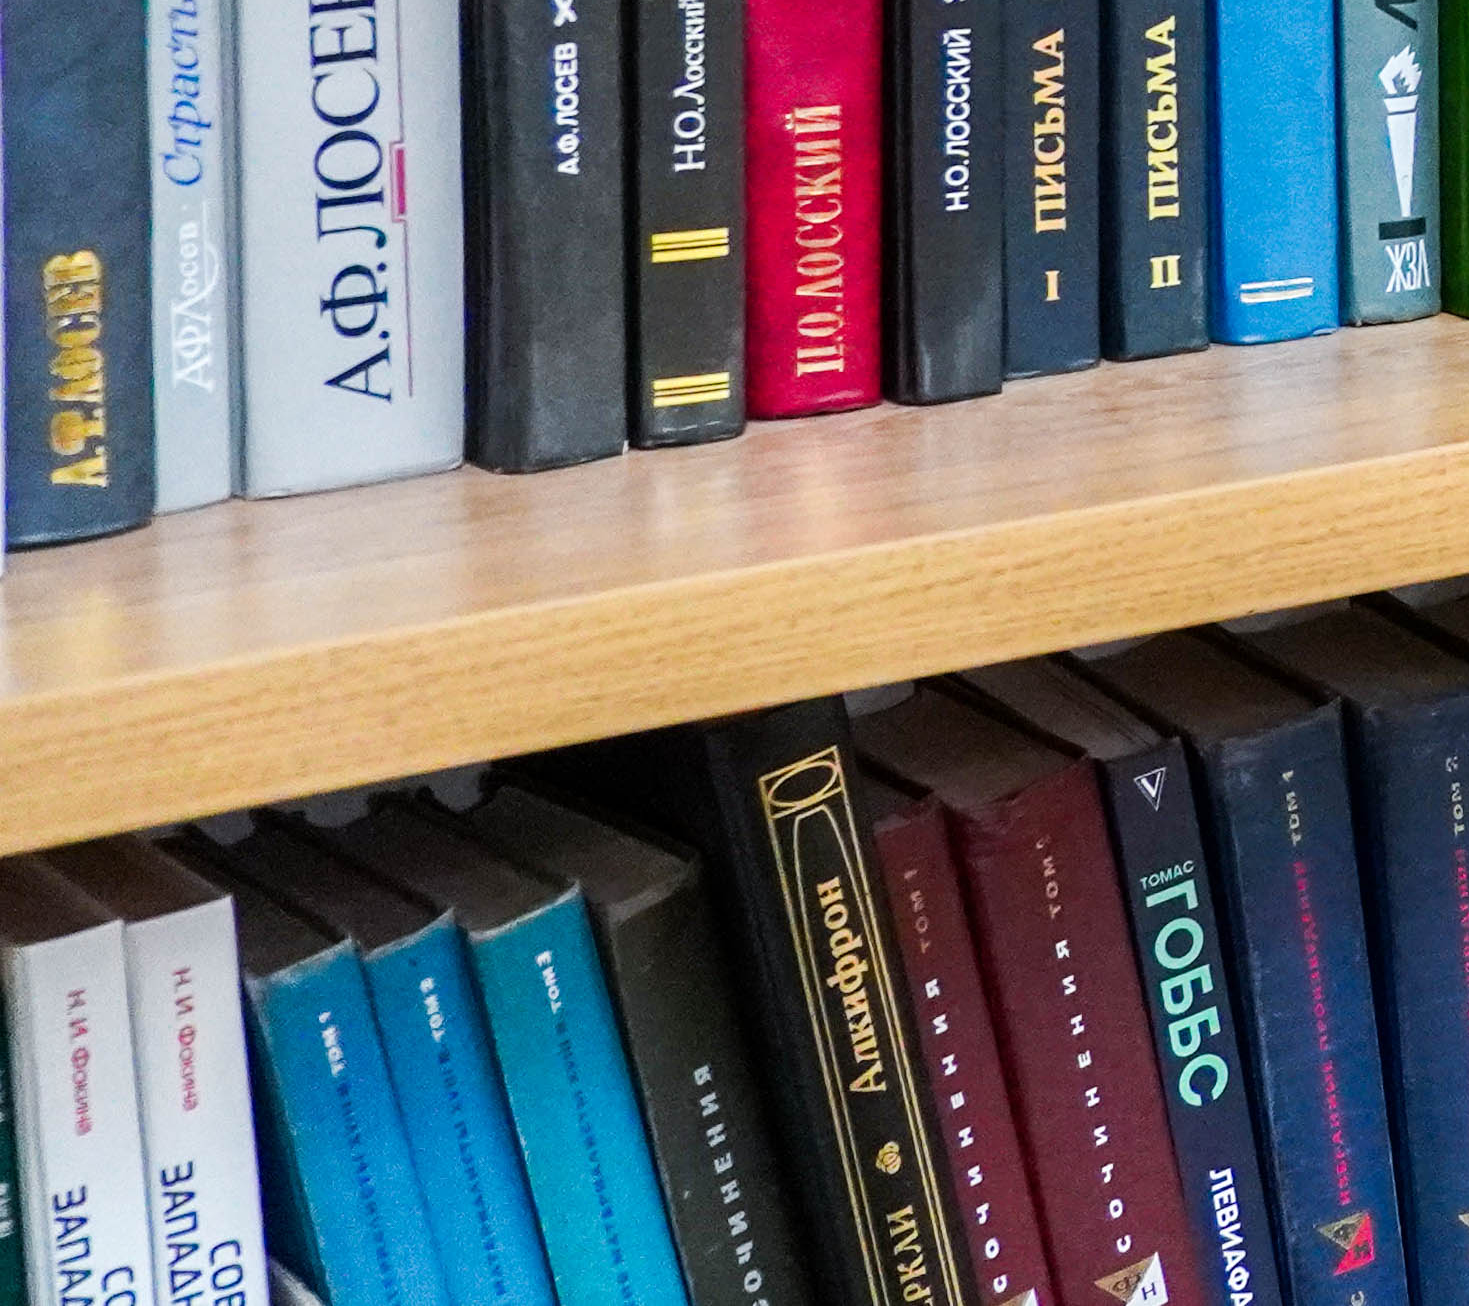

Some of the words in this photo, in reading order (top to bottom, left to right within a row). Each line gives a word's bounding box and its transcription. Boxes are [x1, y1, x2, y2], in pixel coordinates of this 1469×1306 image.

[556, 41, 581, 175] А.Ф.ЛОСЕВ
[1030, 27, 1067, 232] ПИСЬМА
[1143, 14, 1179, 220] ПИСЬМА
[1140, 859, 1196, 892] ТОМАС
[815, 876, 887, 1094] Алкифрон
[1143, 879, 1230, 1108] ГОББС
[923, 977, 1009, 1293] СОЧИНЕНИЯ
[1055, 938, 1133, 1254] СОЧИНЕНИЯ
[1208, 1166, 1254, 1306] ЛЕВИАФА
